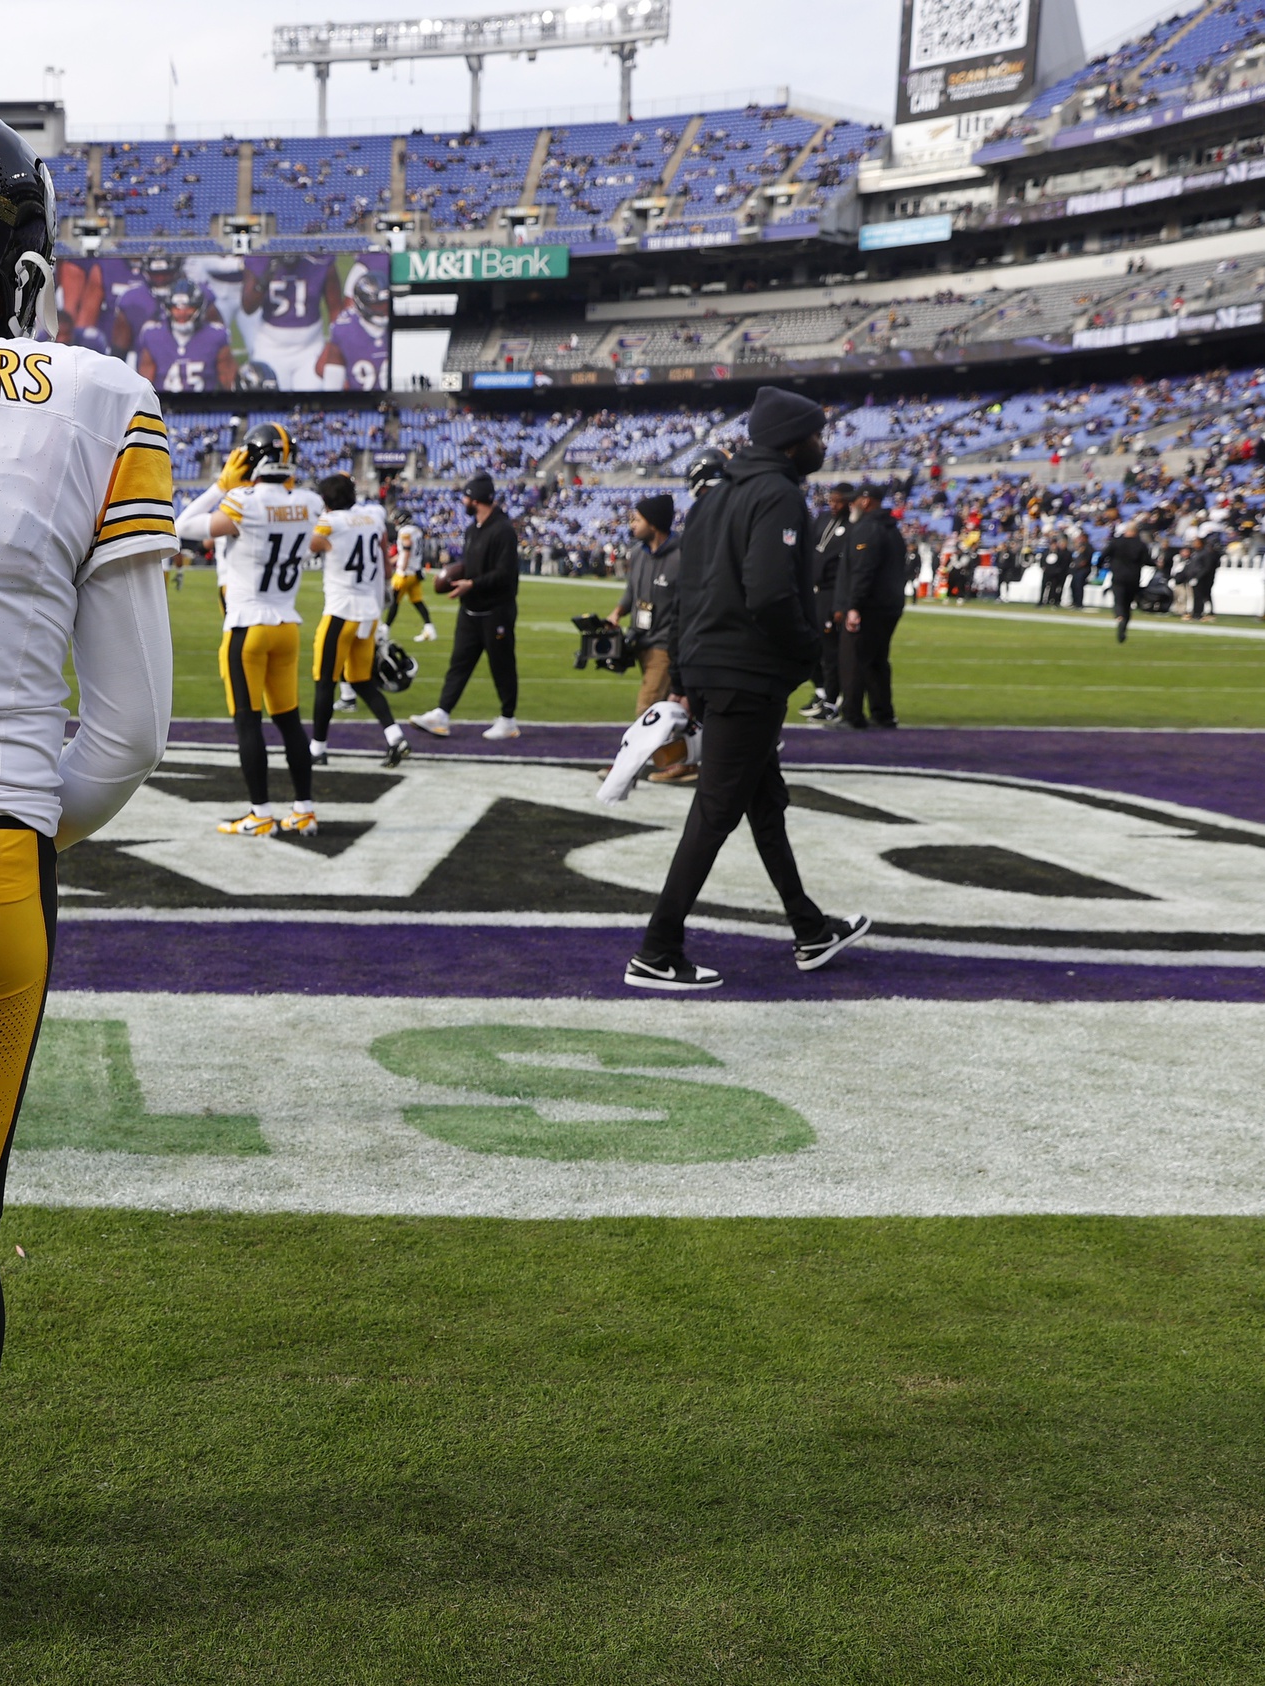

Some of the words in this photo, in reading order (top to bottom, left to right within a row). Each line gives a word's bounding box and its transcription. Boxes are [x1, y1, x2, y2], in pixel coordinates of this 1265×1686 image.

[408, 248, 480, 282] M&T
[481, 246, 552, 279] Bank
[269, 279, 307, 318] 51
[163, 360, 205, 393] 45
[259, 532, 306, 592] 16
[344, 532, 380, 583] 49
